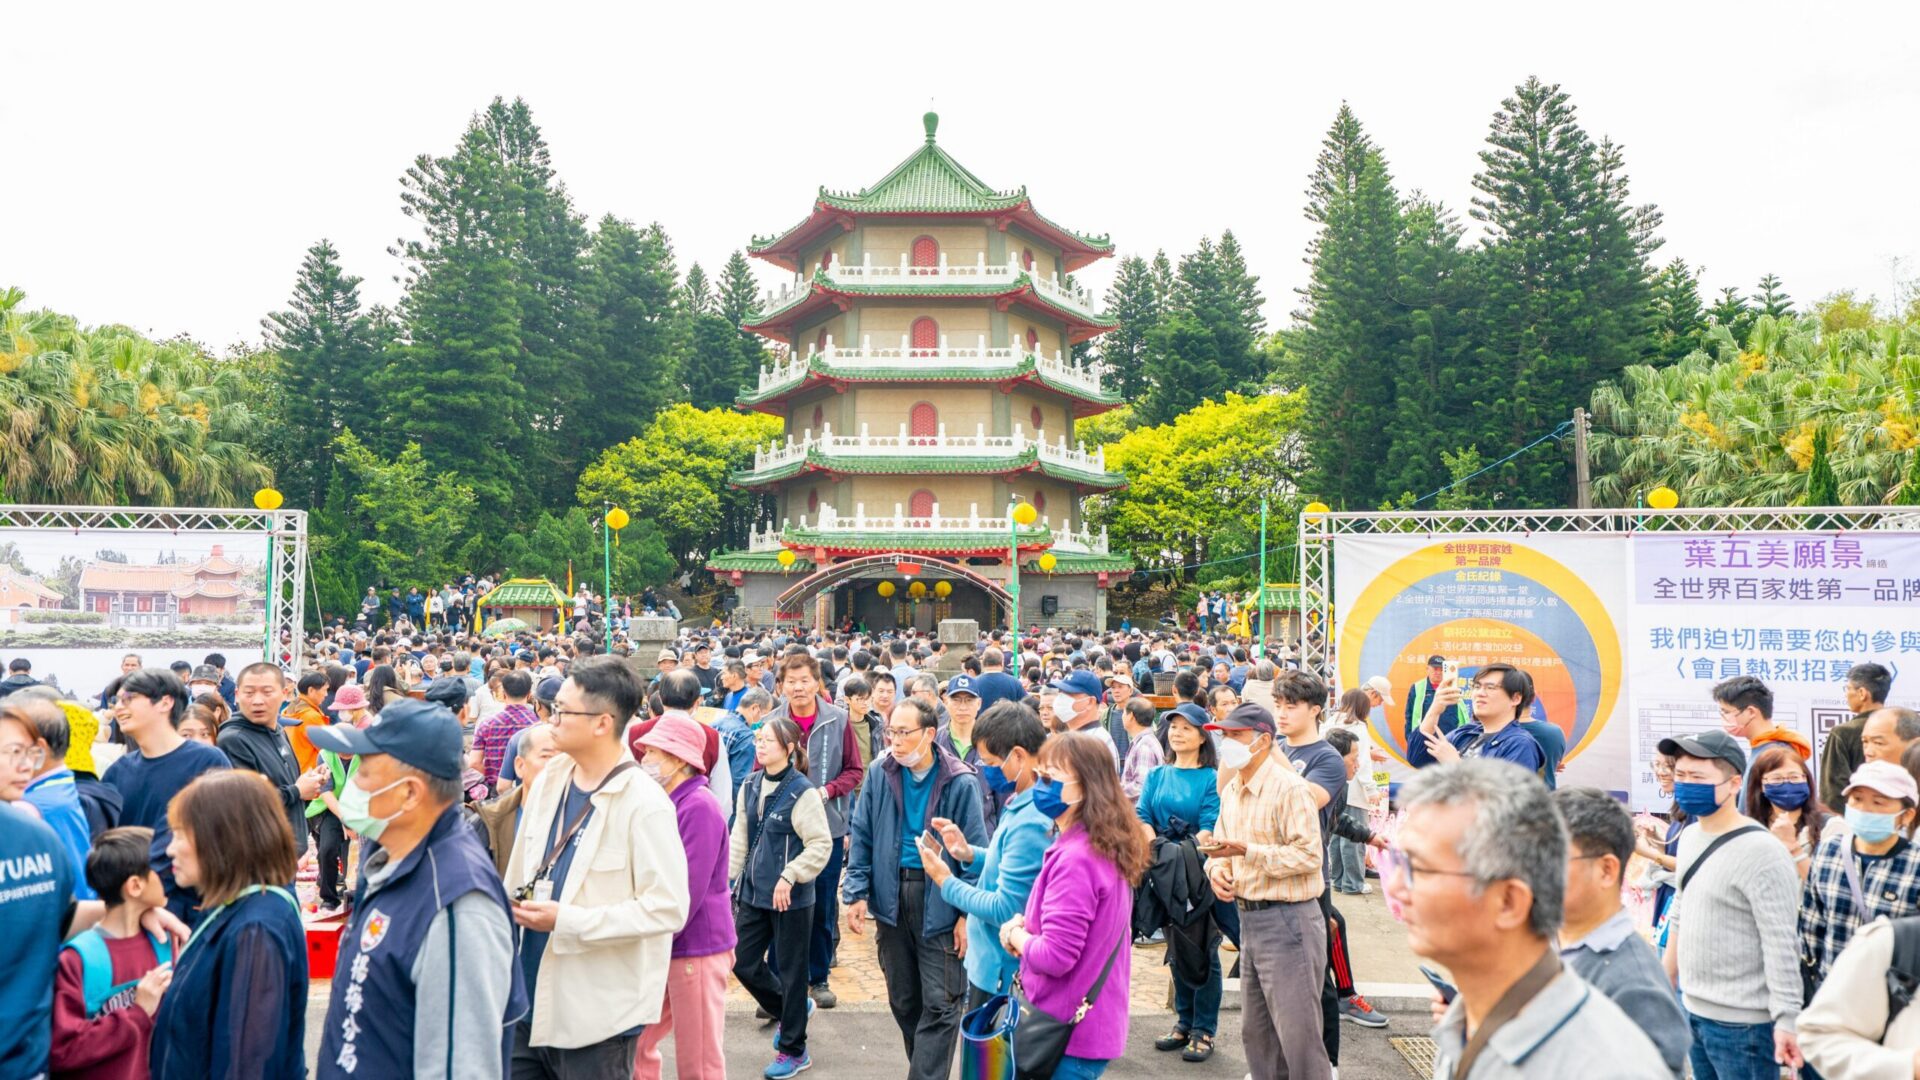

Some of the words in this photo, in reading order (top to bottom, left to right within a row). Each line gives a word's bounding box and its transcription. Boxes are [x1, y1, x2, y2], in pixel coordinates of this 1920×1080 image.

[1443, 543, 1513, 555] 全世界百家姓
[1455, 555, 1502, 567] 第一品牌
[1684, 539, 1864, 569] 葉五美願景
[1653, 577, 1920, 602] 全世界百家姓第一品牌
[1650, 626, 1920, 653] 我們迫切需要您的參與
[0, 852, 54, 883] YUAN
[336, 951, 370, 1074] 楊梅分局
